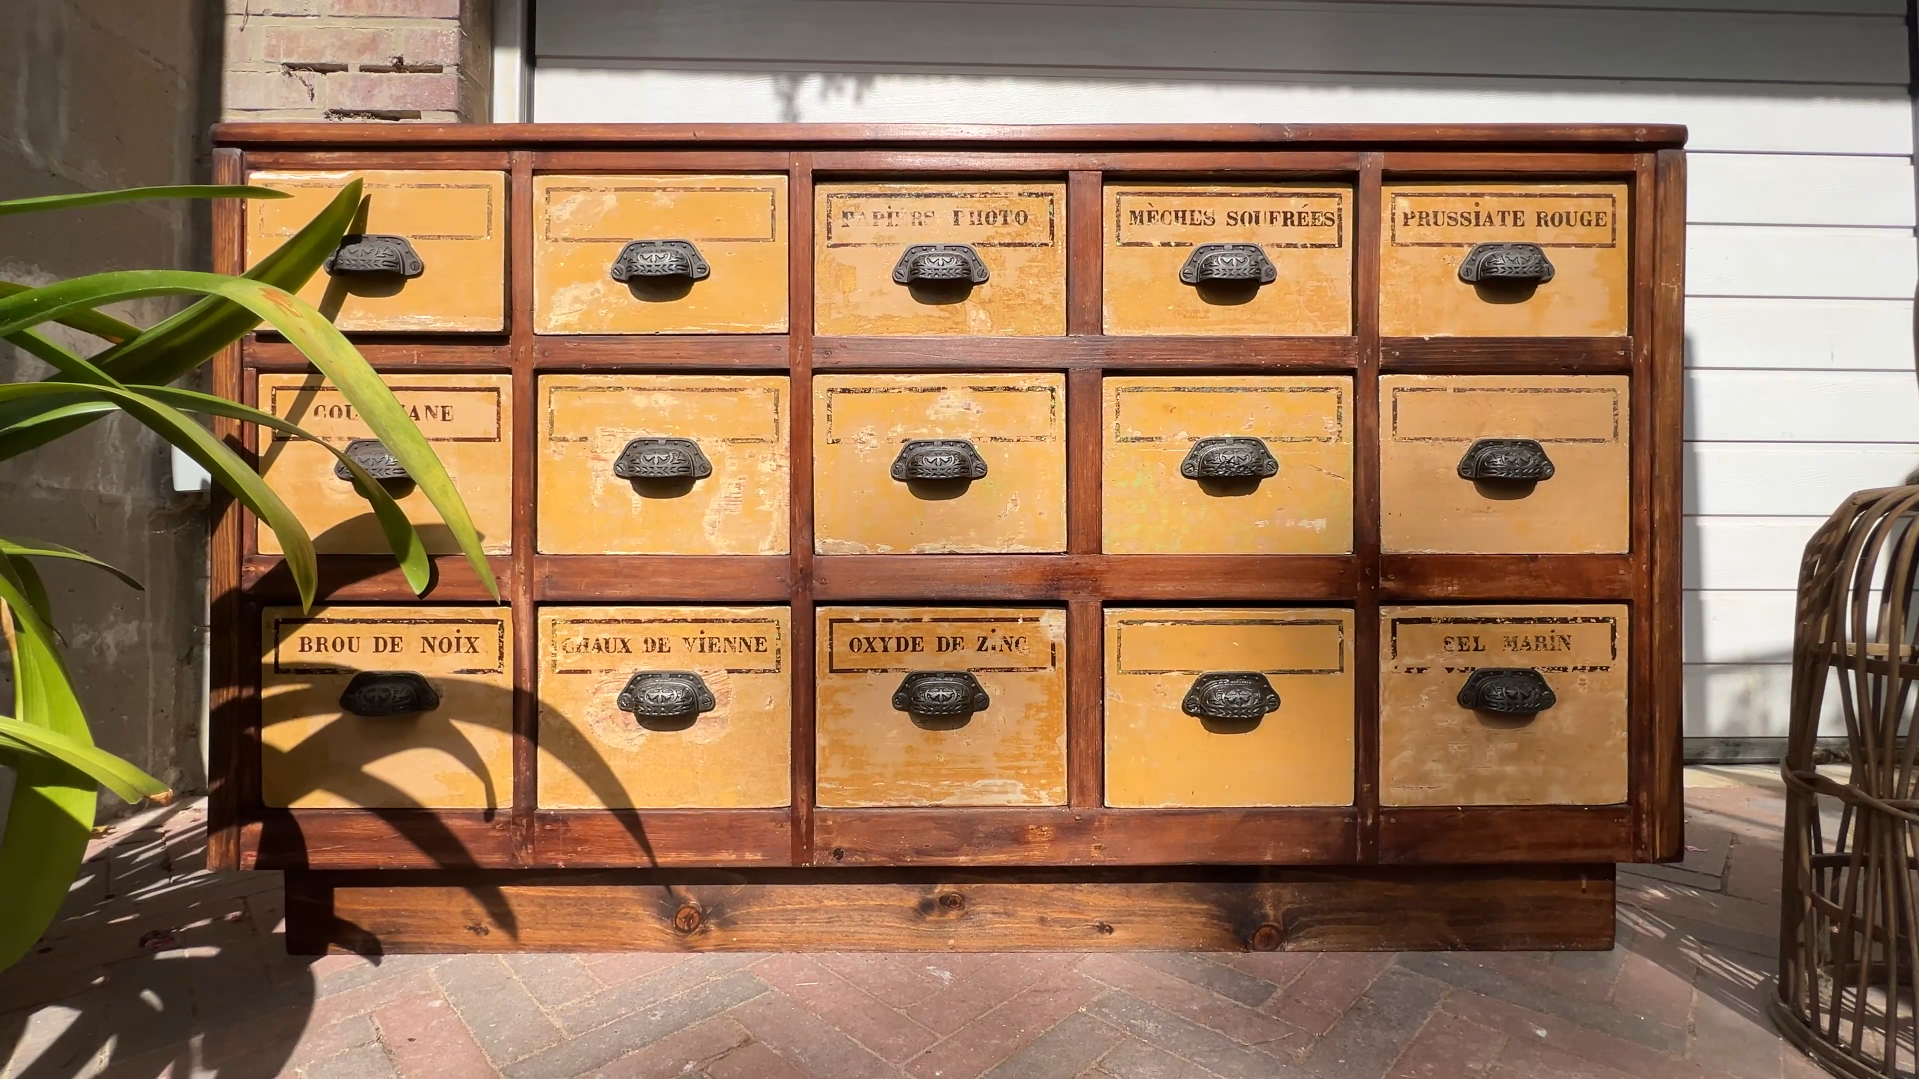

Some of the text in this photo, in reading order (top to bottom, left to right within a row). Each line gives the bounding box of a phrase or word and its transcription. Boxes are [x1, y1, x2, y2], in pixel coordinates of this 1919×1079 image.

[952, 209, 1028, 226] PHOTO
[1129, 202, 1336, 227] MÈCHES SOUFRÉES
[1535, 210, 1607, 227] ROUGE
[313, 404, 454, 422] COLANE
[298, 636, 361, 653] BROU
[373, 636, 403, 653] DE
[642, 636, 671, 653] DE
[848, 636, 924, 653] OXYDE
[936, 636, 965, 653] DE
[1443, 635, 1486, 652] SEL
